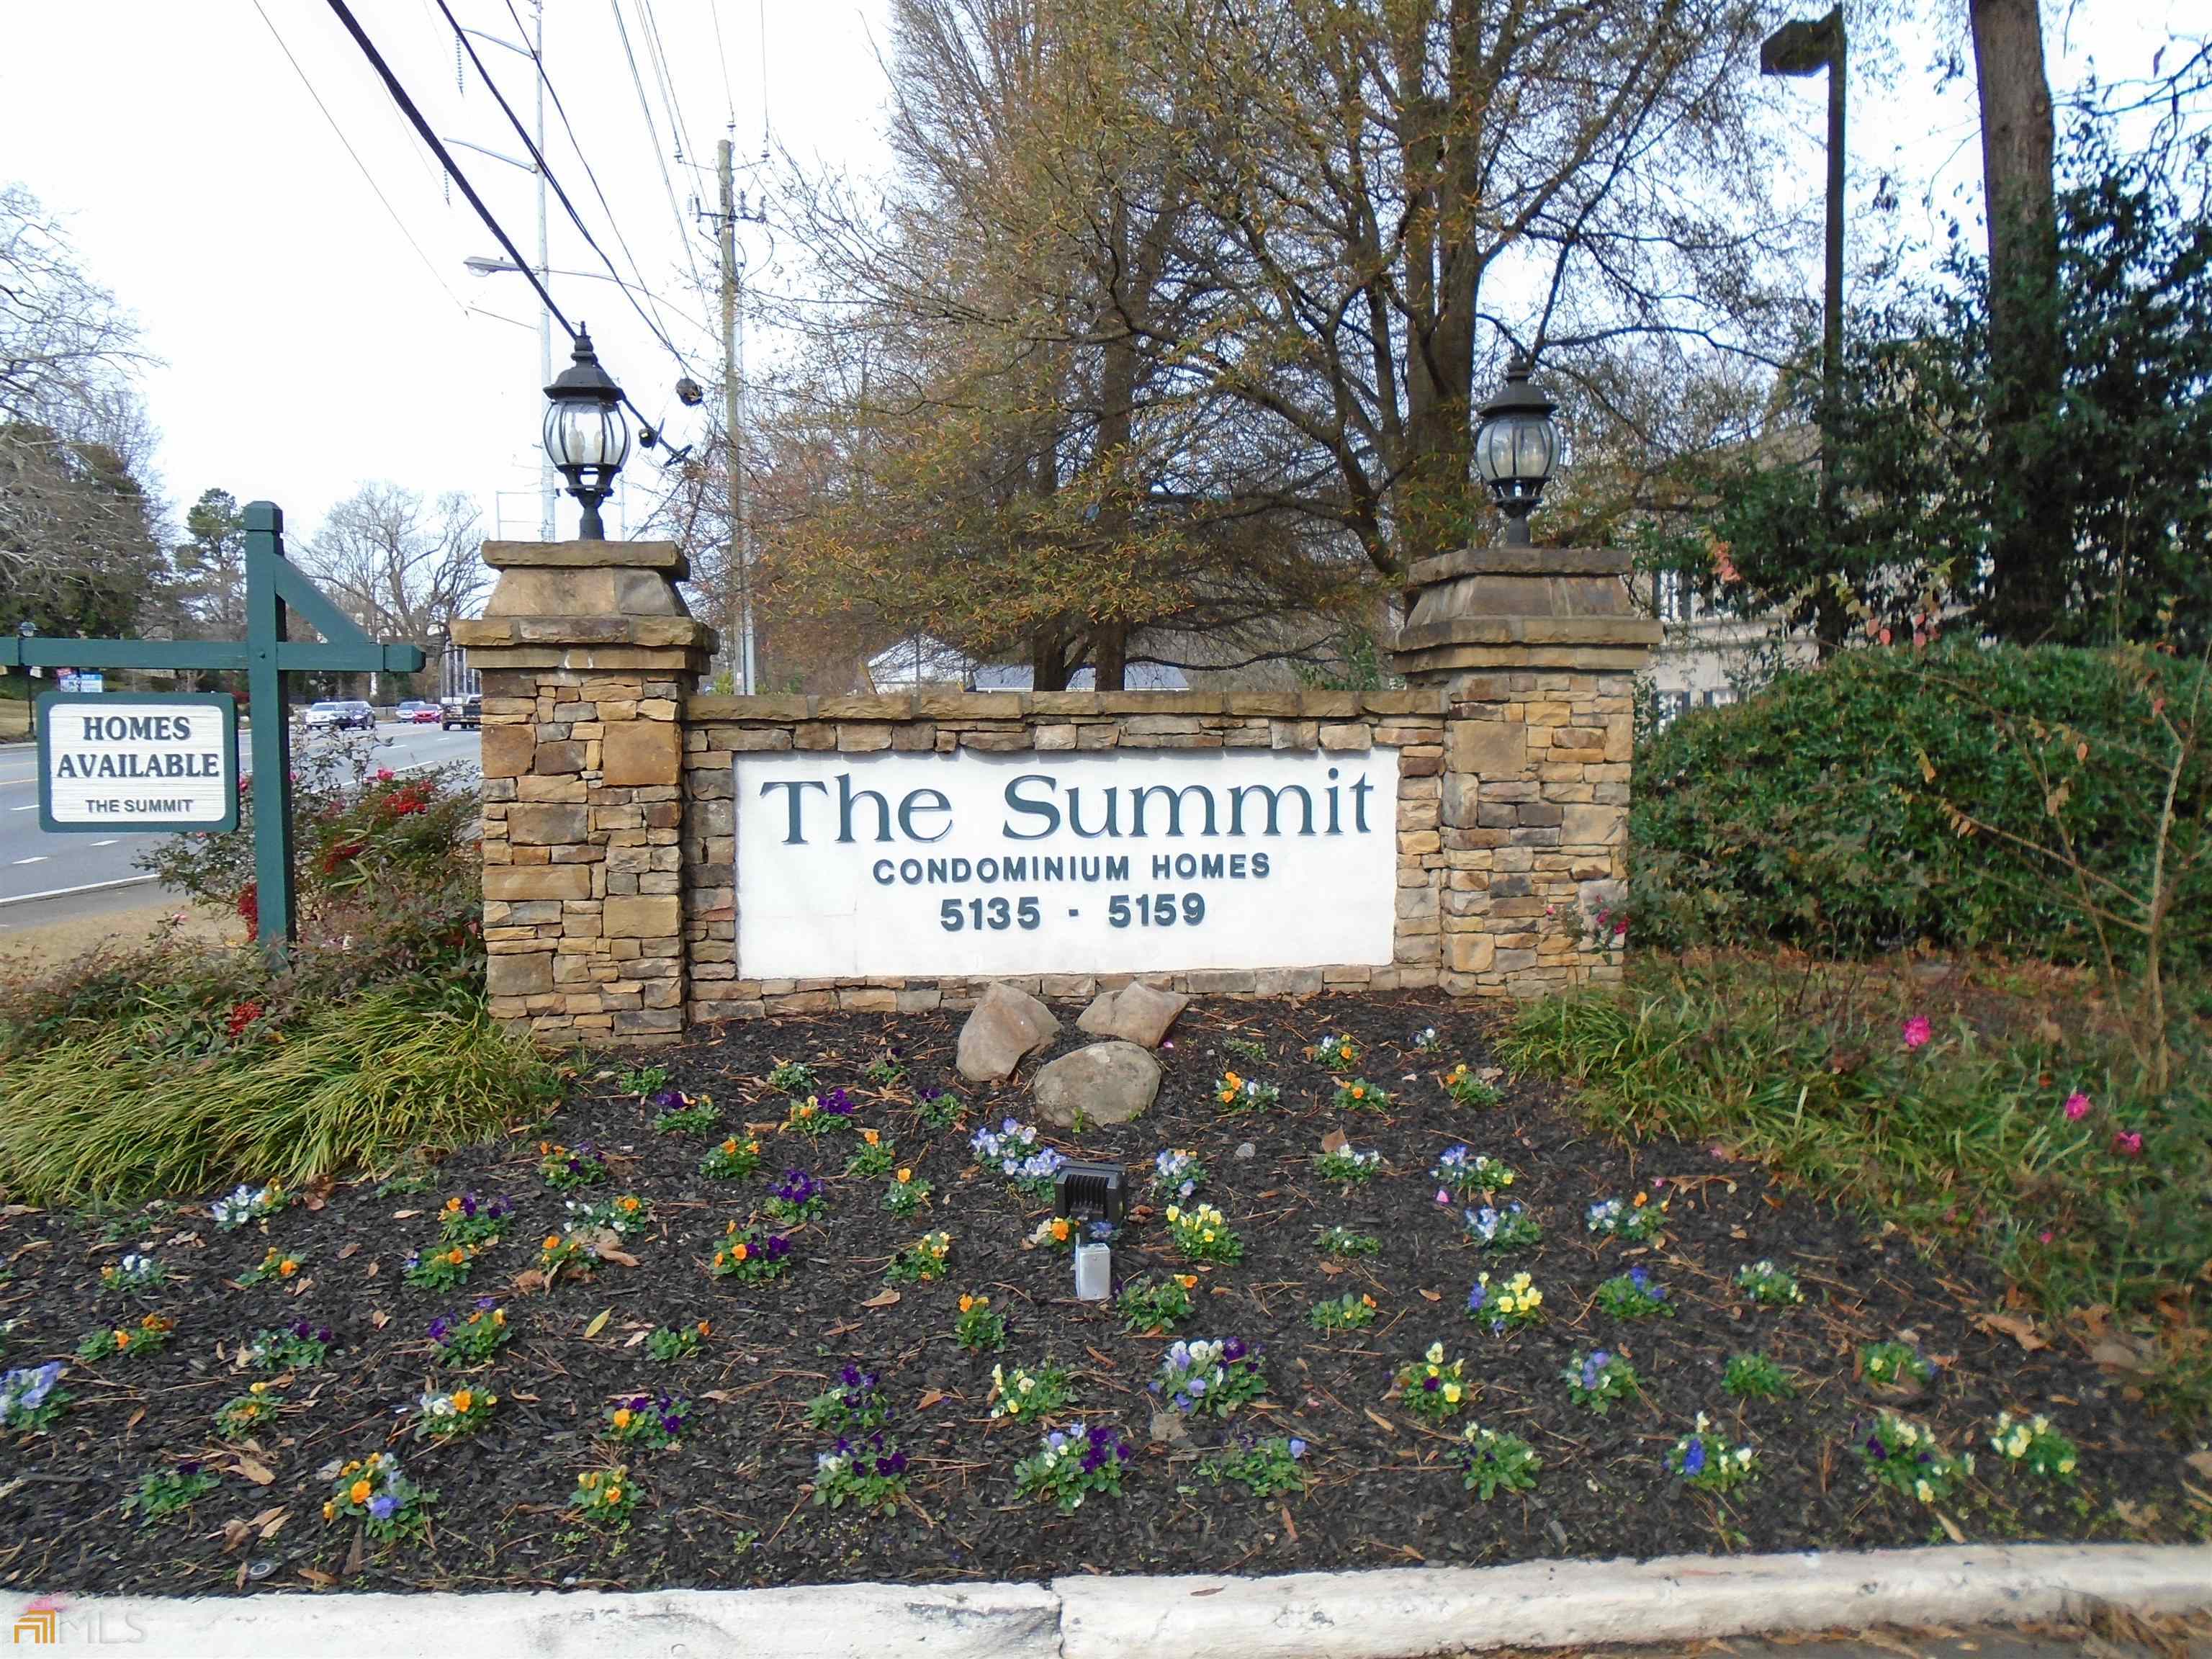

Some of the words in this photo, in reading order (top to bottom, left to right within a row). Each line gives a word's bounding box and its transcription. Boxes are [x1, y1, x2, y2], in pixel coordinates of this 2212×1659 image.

[82, 716, 191, 740] HOMES
[58, 753, 220, 778] AVAILABLE
[86, 799, 120, 812] THE
[124, 799, 194, 812] SUMMIT
[759, 773, 953, 845] The
[1002, 767, 1374, 840] Summit
[872, 855, 1130, 885] CONDOMINIUM
[1152, 853, 1270, 880] HOMES
[940, 896, 1041, 932] 5135
[1107, 893, 1205, 927] 5159
